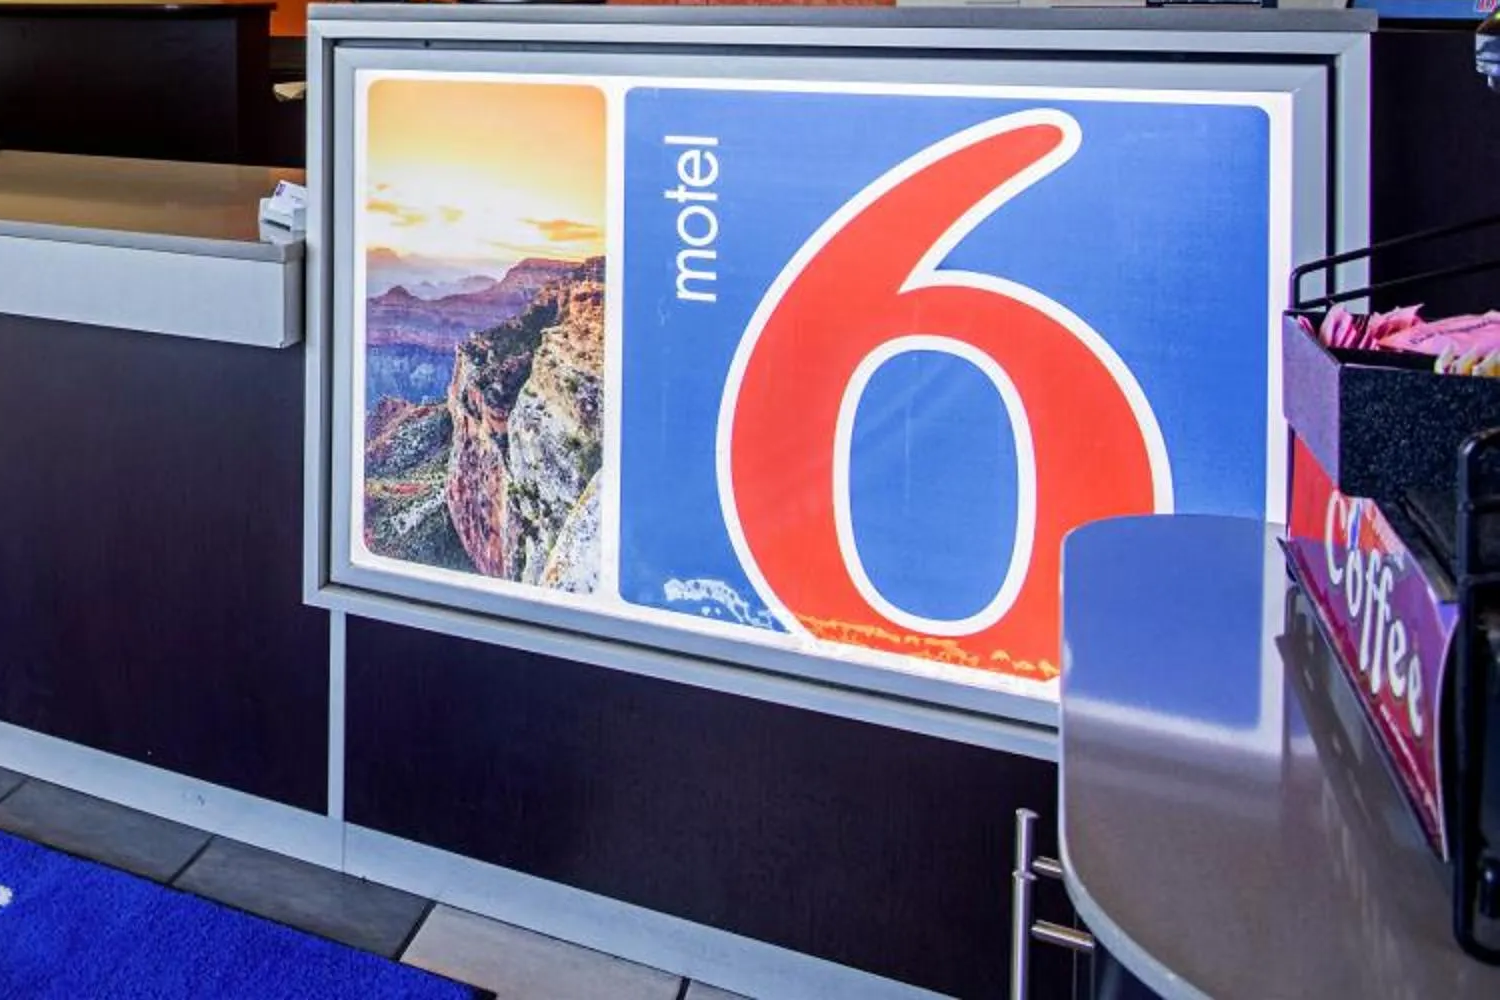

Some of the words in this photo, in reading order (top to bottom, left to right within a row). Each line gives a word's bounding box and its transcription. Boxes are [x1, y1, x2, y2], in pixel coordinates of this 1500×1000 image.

[663, 134, 720, 303] motel
[715, 107, 1175, 684] 6
[1324, 489, 1424, 738] Coffee
